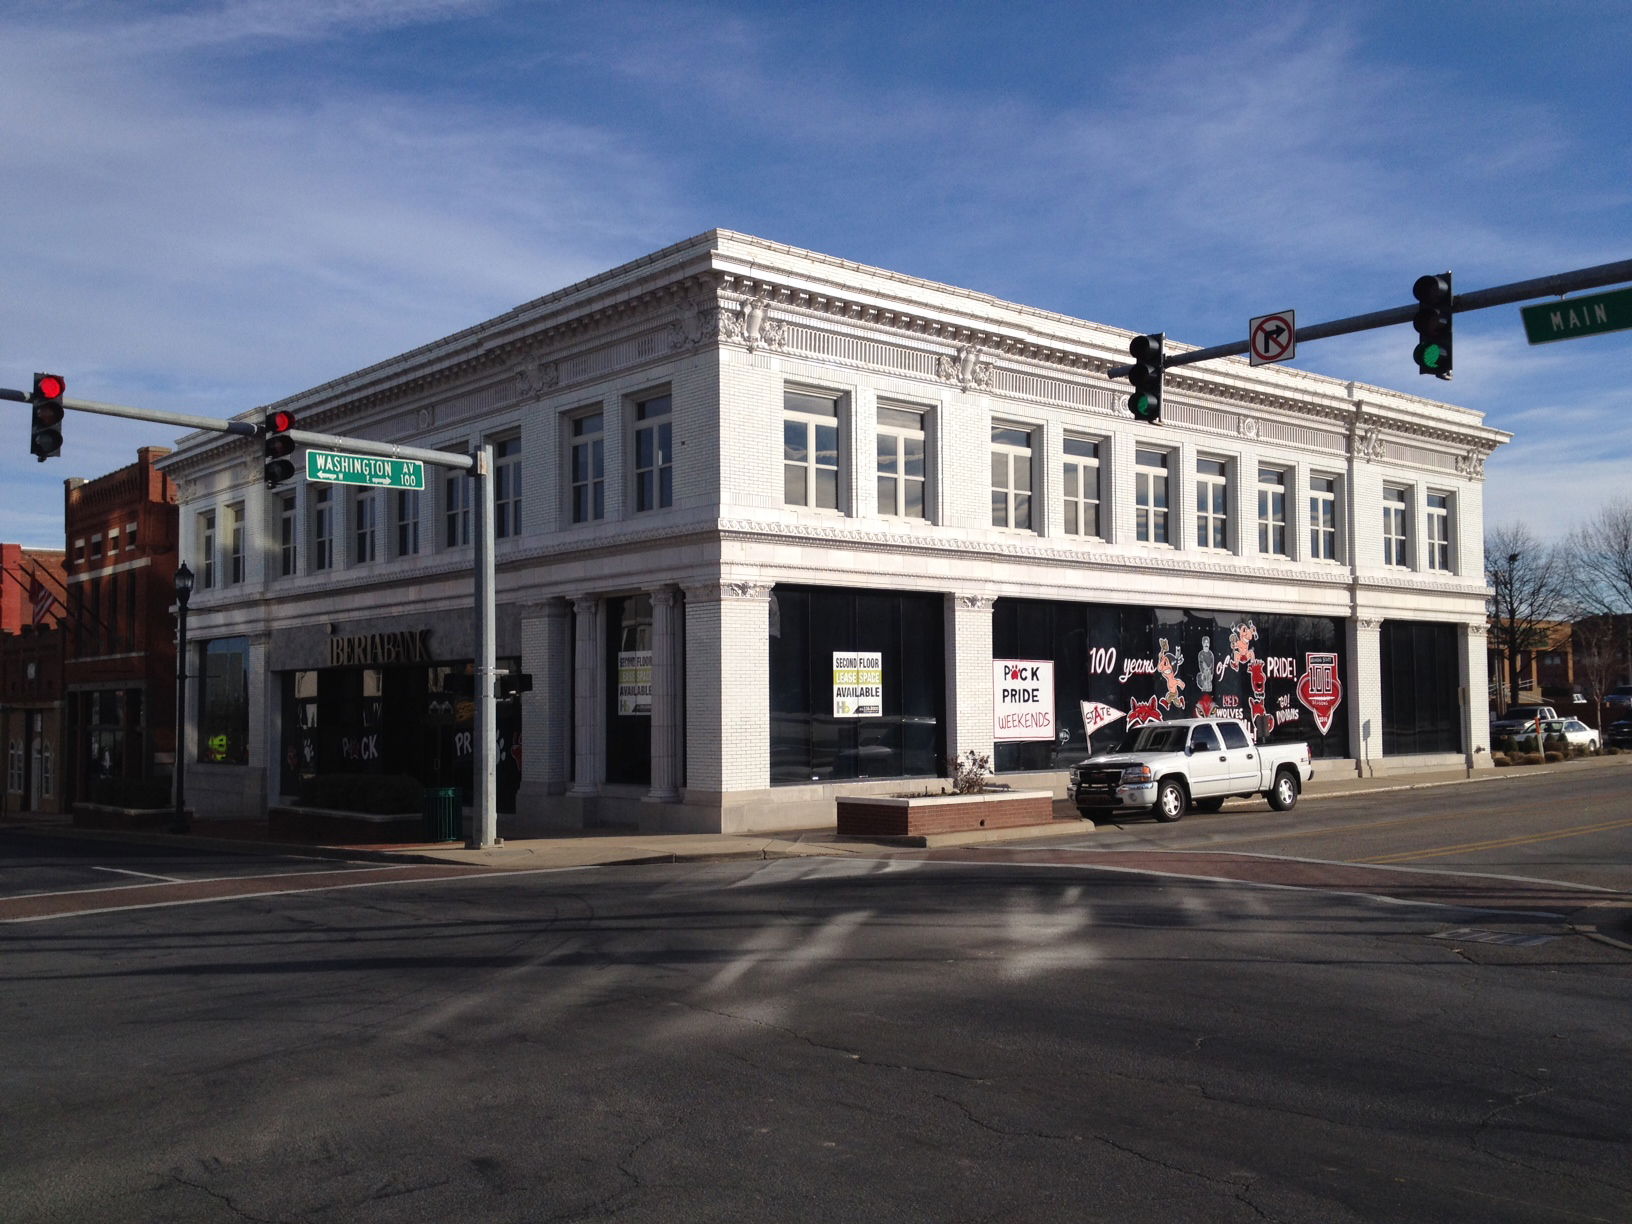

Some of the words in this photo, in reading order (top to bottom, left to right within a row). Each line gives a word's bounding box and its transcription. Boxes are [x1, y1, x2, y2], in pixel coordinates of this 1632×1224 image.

[1550, 303, 1608, 332] MAIN
[316, 454, 392, 476] WASHINGTON
[402, 463, 414, 474] AV
[400, 474, 416, 486] 100
[330, 630, 429, 665] IBERIABANK
[835, 657, 858, 668] SECOND
[859, 657, 880, 668] FLOOR
[1089, 647, 1117, 675] 100
[1118, 656, 1157, 684] years
[1216, 655, 1231, 682] of
[1267, 656, 1298, 682] PRIDE!
[836, 671, 857, 683] LEASE
[859, 671, 880, 683] SPACE
[836, 687, 880, 698] AVAILABLE
[1002, 688, 1040, 703] PRIDE
[998, 712, 1051, 730] WEEKENDS
[1085, 705, 1111, 725] STATE
[1216, 708, 1244, 719] WOLVES
